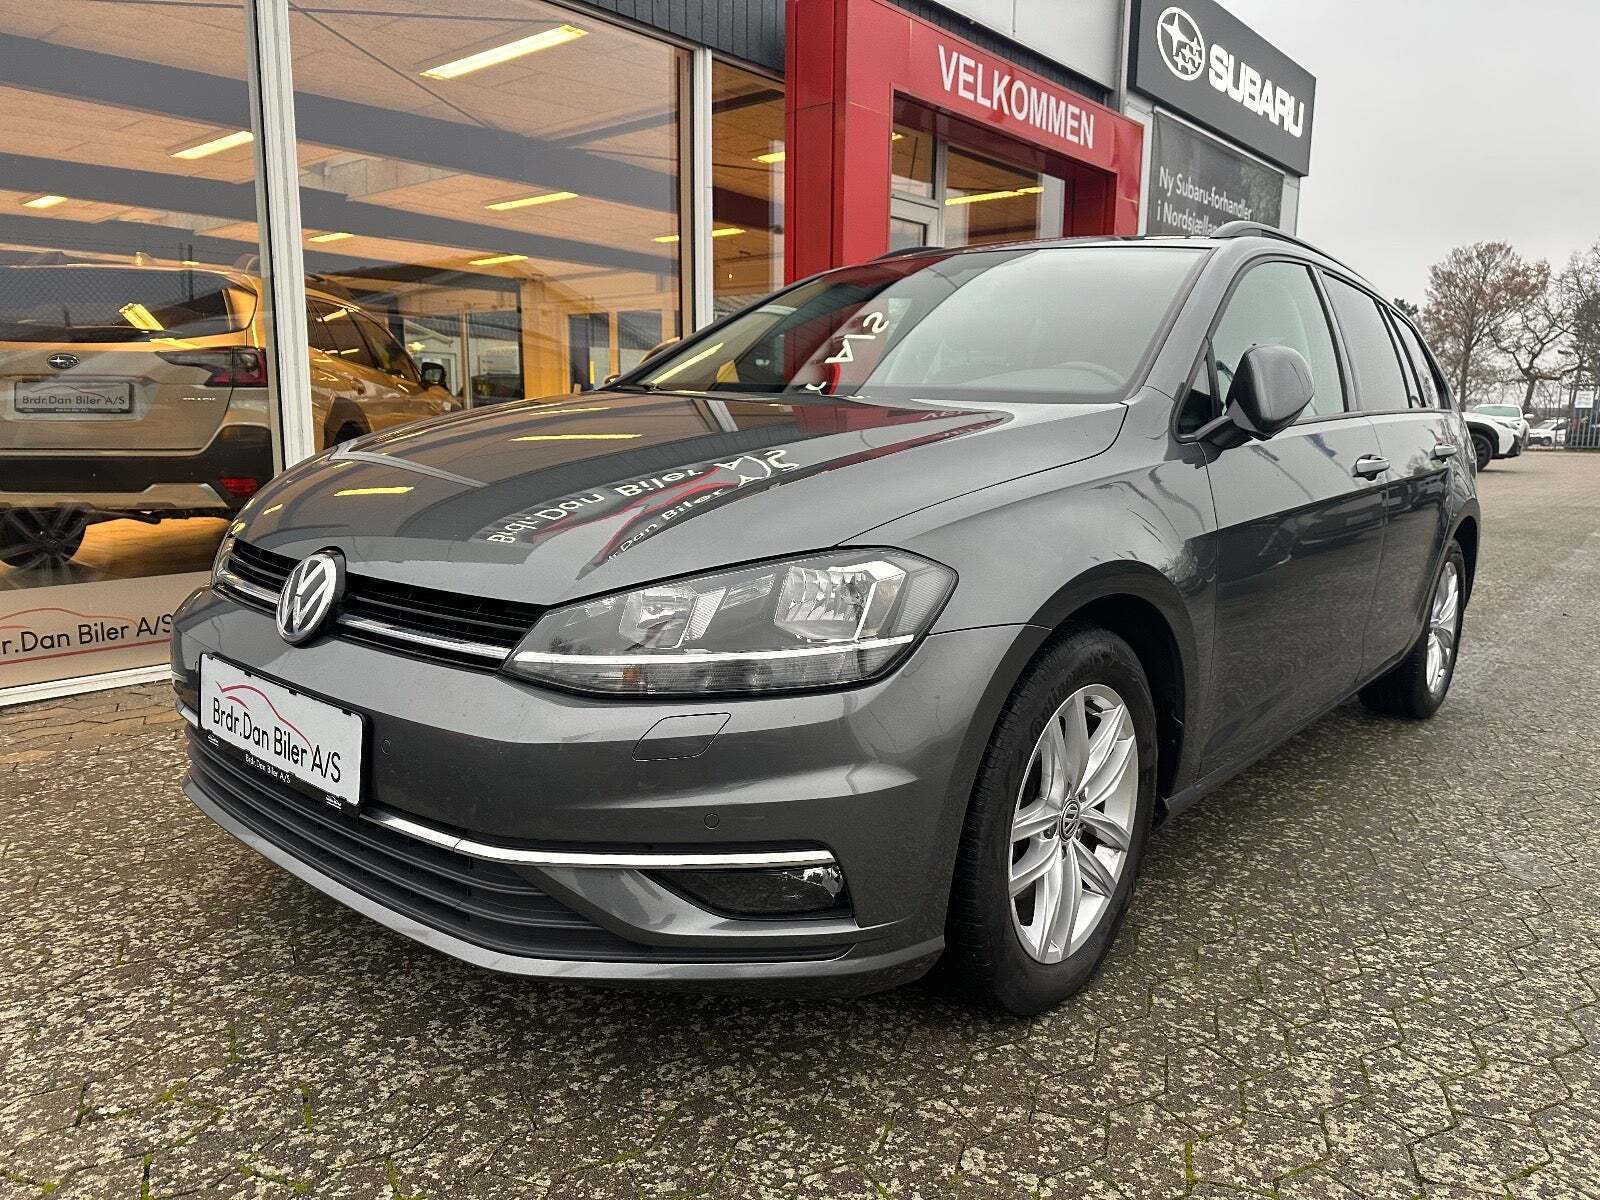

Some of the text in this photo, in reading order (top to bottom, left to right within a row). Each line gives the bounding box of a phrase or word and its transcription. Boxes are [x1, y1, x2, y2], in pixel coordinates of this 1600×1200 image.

[937, 44, 1095, 150] VELKOMMEN
[1208, 43, 1305, 139] SUBARU
[1160, 165, 1174, 197] Ny
[75, 395, 101, 405] Biler
[105, 395, 125, 406] A/S
[78, 622, 130, 645] Biler
[136, 613, 173, 637] A/S
[213, 696, 341, 784] Brdr.Dan Biler A/S
